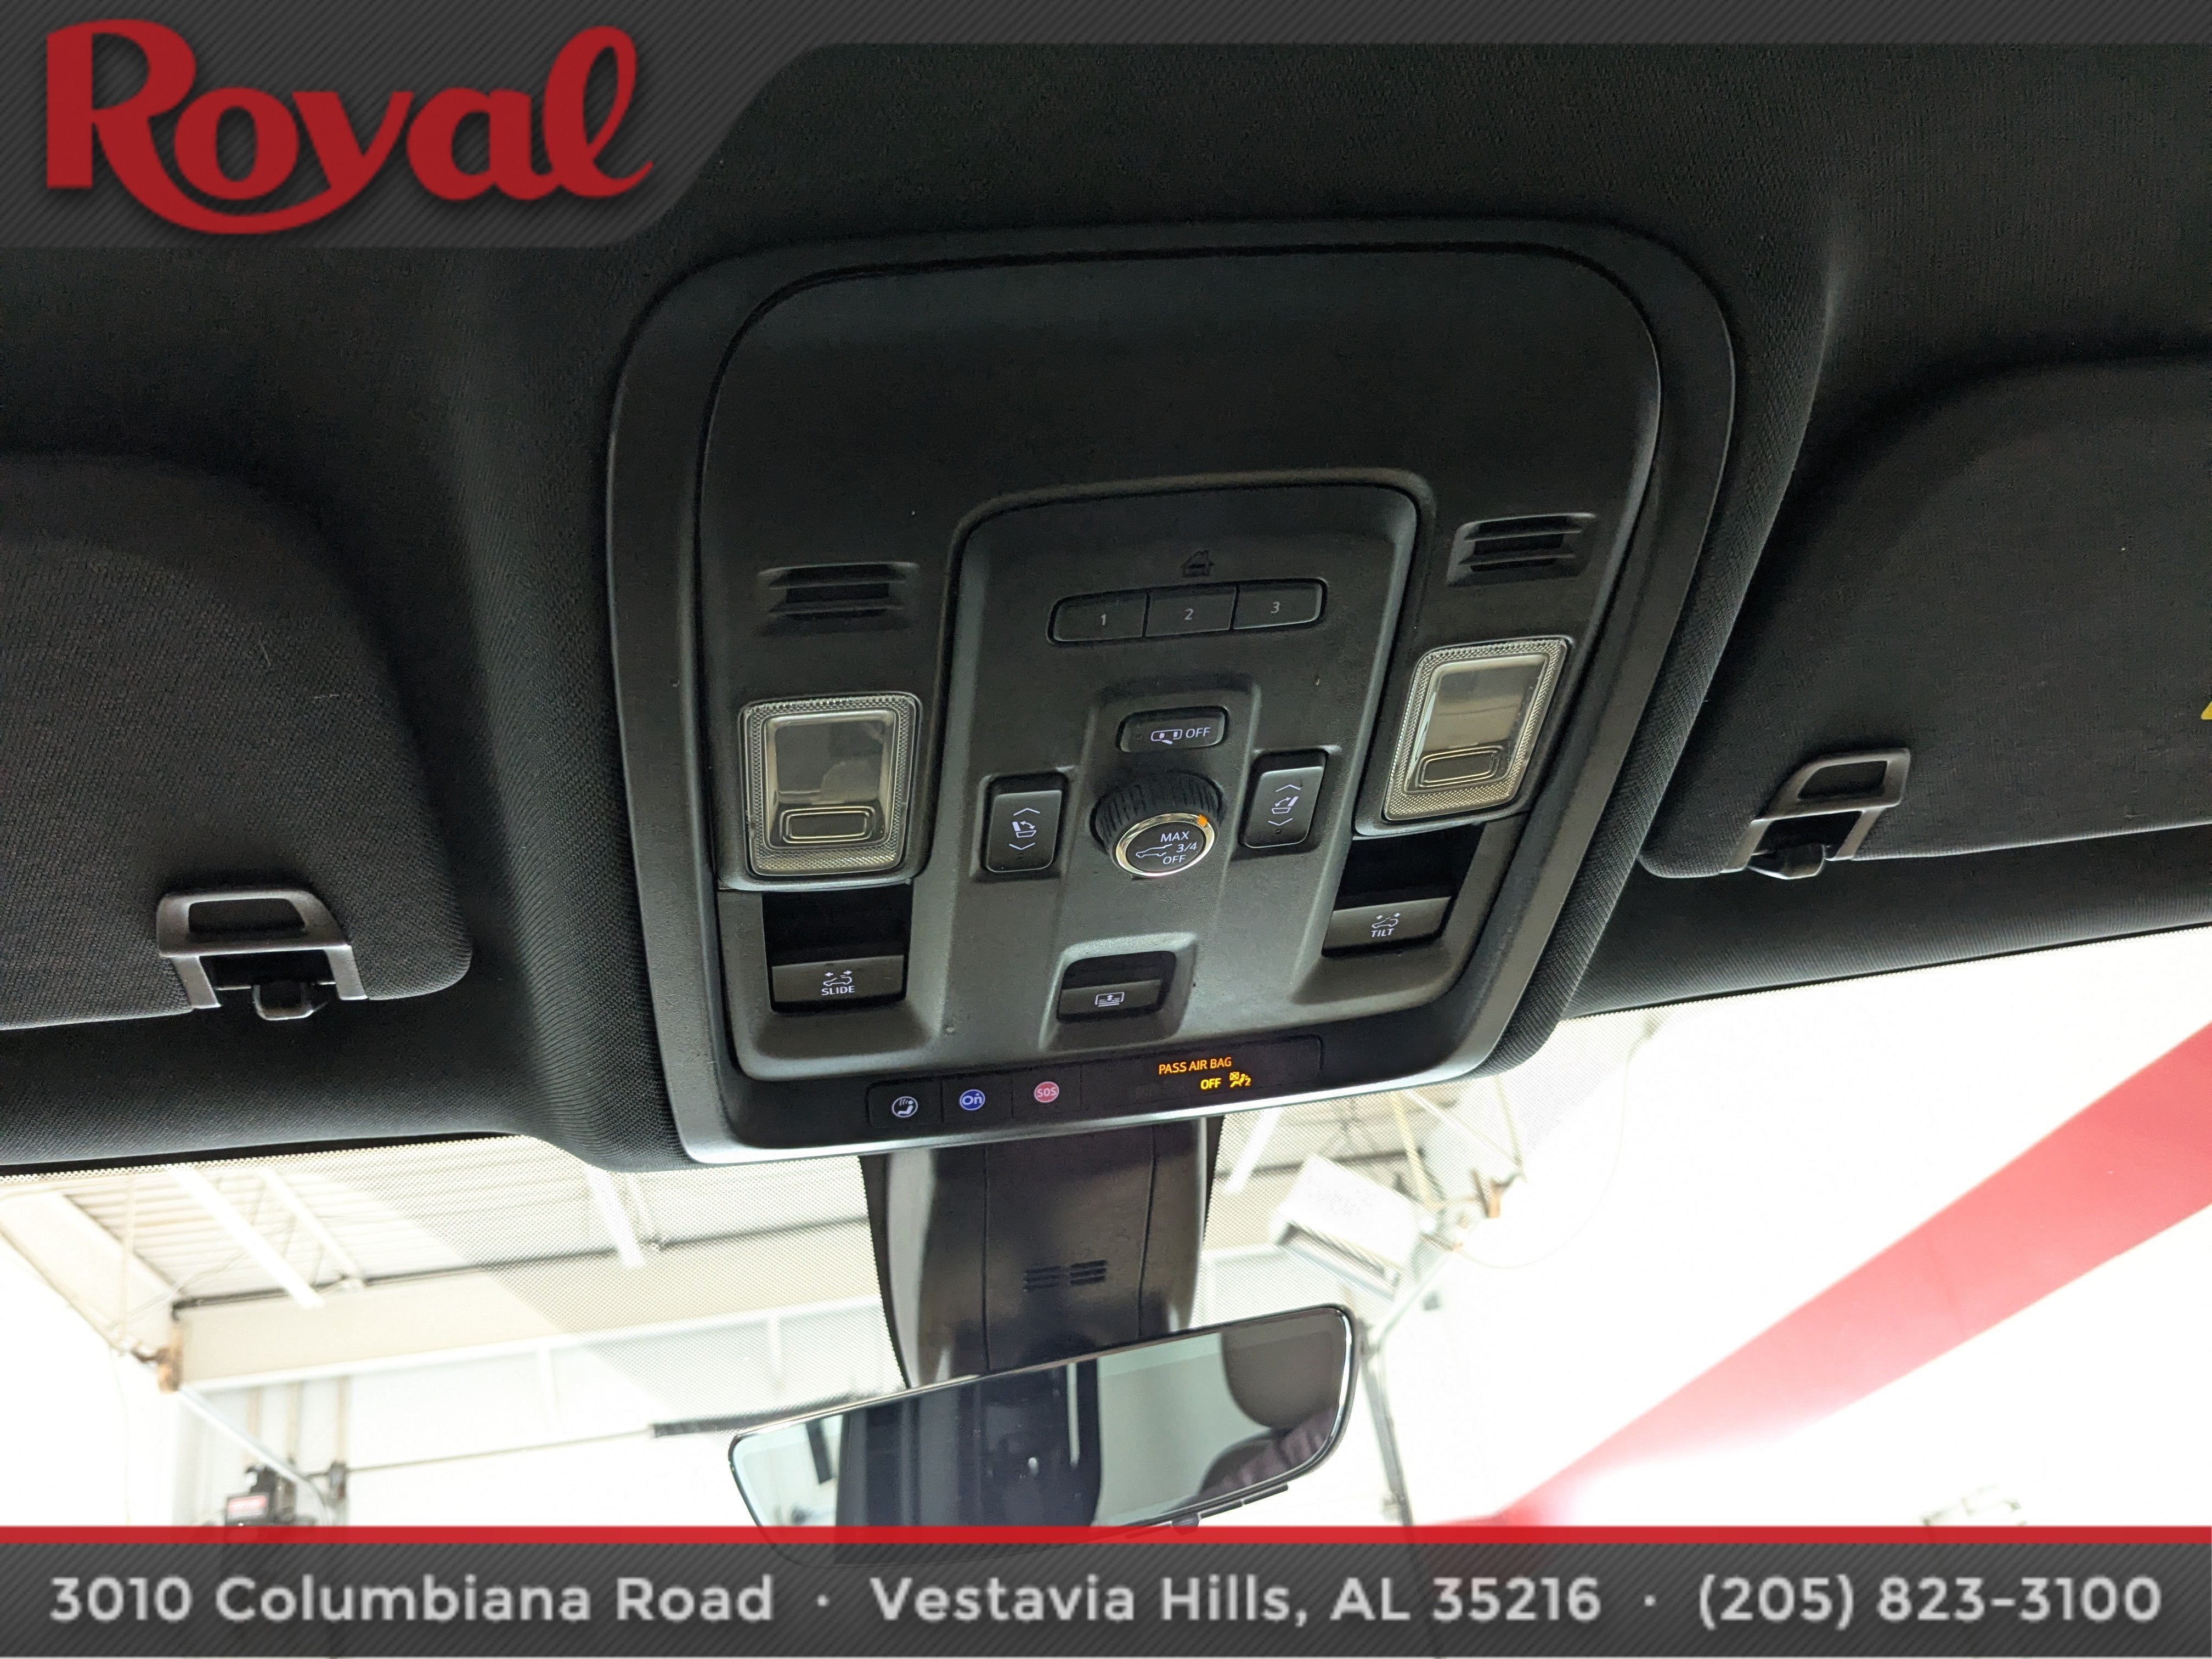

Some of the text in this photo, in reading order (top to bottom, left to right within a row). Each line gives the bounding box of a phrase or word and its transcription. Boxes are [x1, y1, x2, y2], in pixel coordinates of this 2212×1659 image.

[1271, 601, 1280, 614] 3
[1184, 608, 1194, 620] 2
[1099, 614, 1107, 627] 1
[1185, 727, 1211, 738] OFF
[1160, 831, 1190, 843] MAX
[1176, 842, 1198, 853] 3/4
[1163, 854, 1187, 865] OFF
[1370, 928, 1395, 938] TILT
[821, 985, 855, 996] SLIDE
[1158, 1057, 1232, 1075] PASS AIR BAG
[1200, 1077, 1222, 1090] OFF
[1036, 1086, 1057, 1097] SOS
